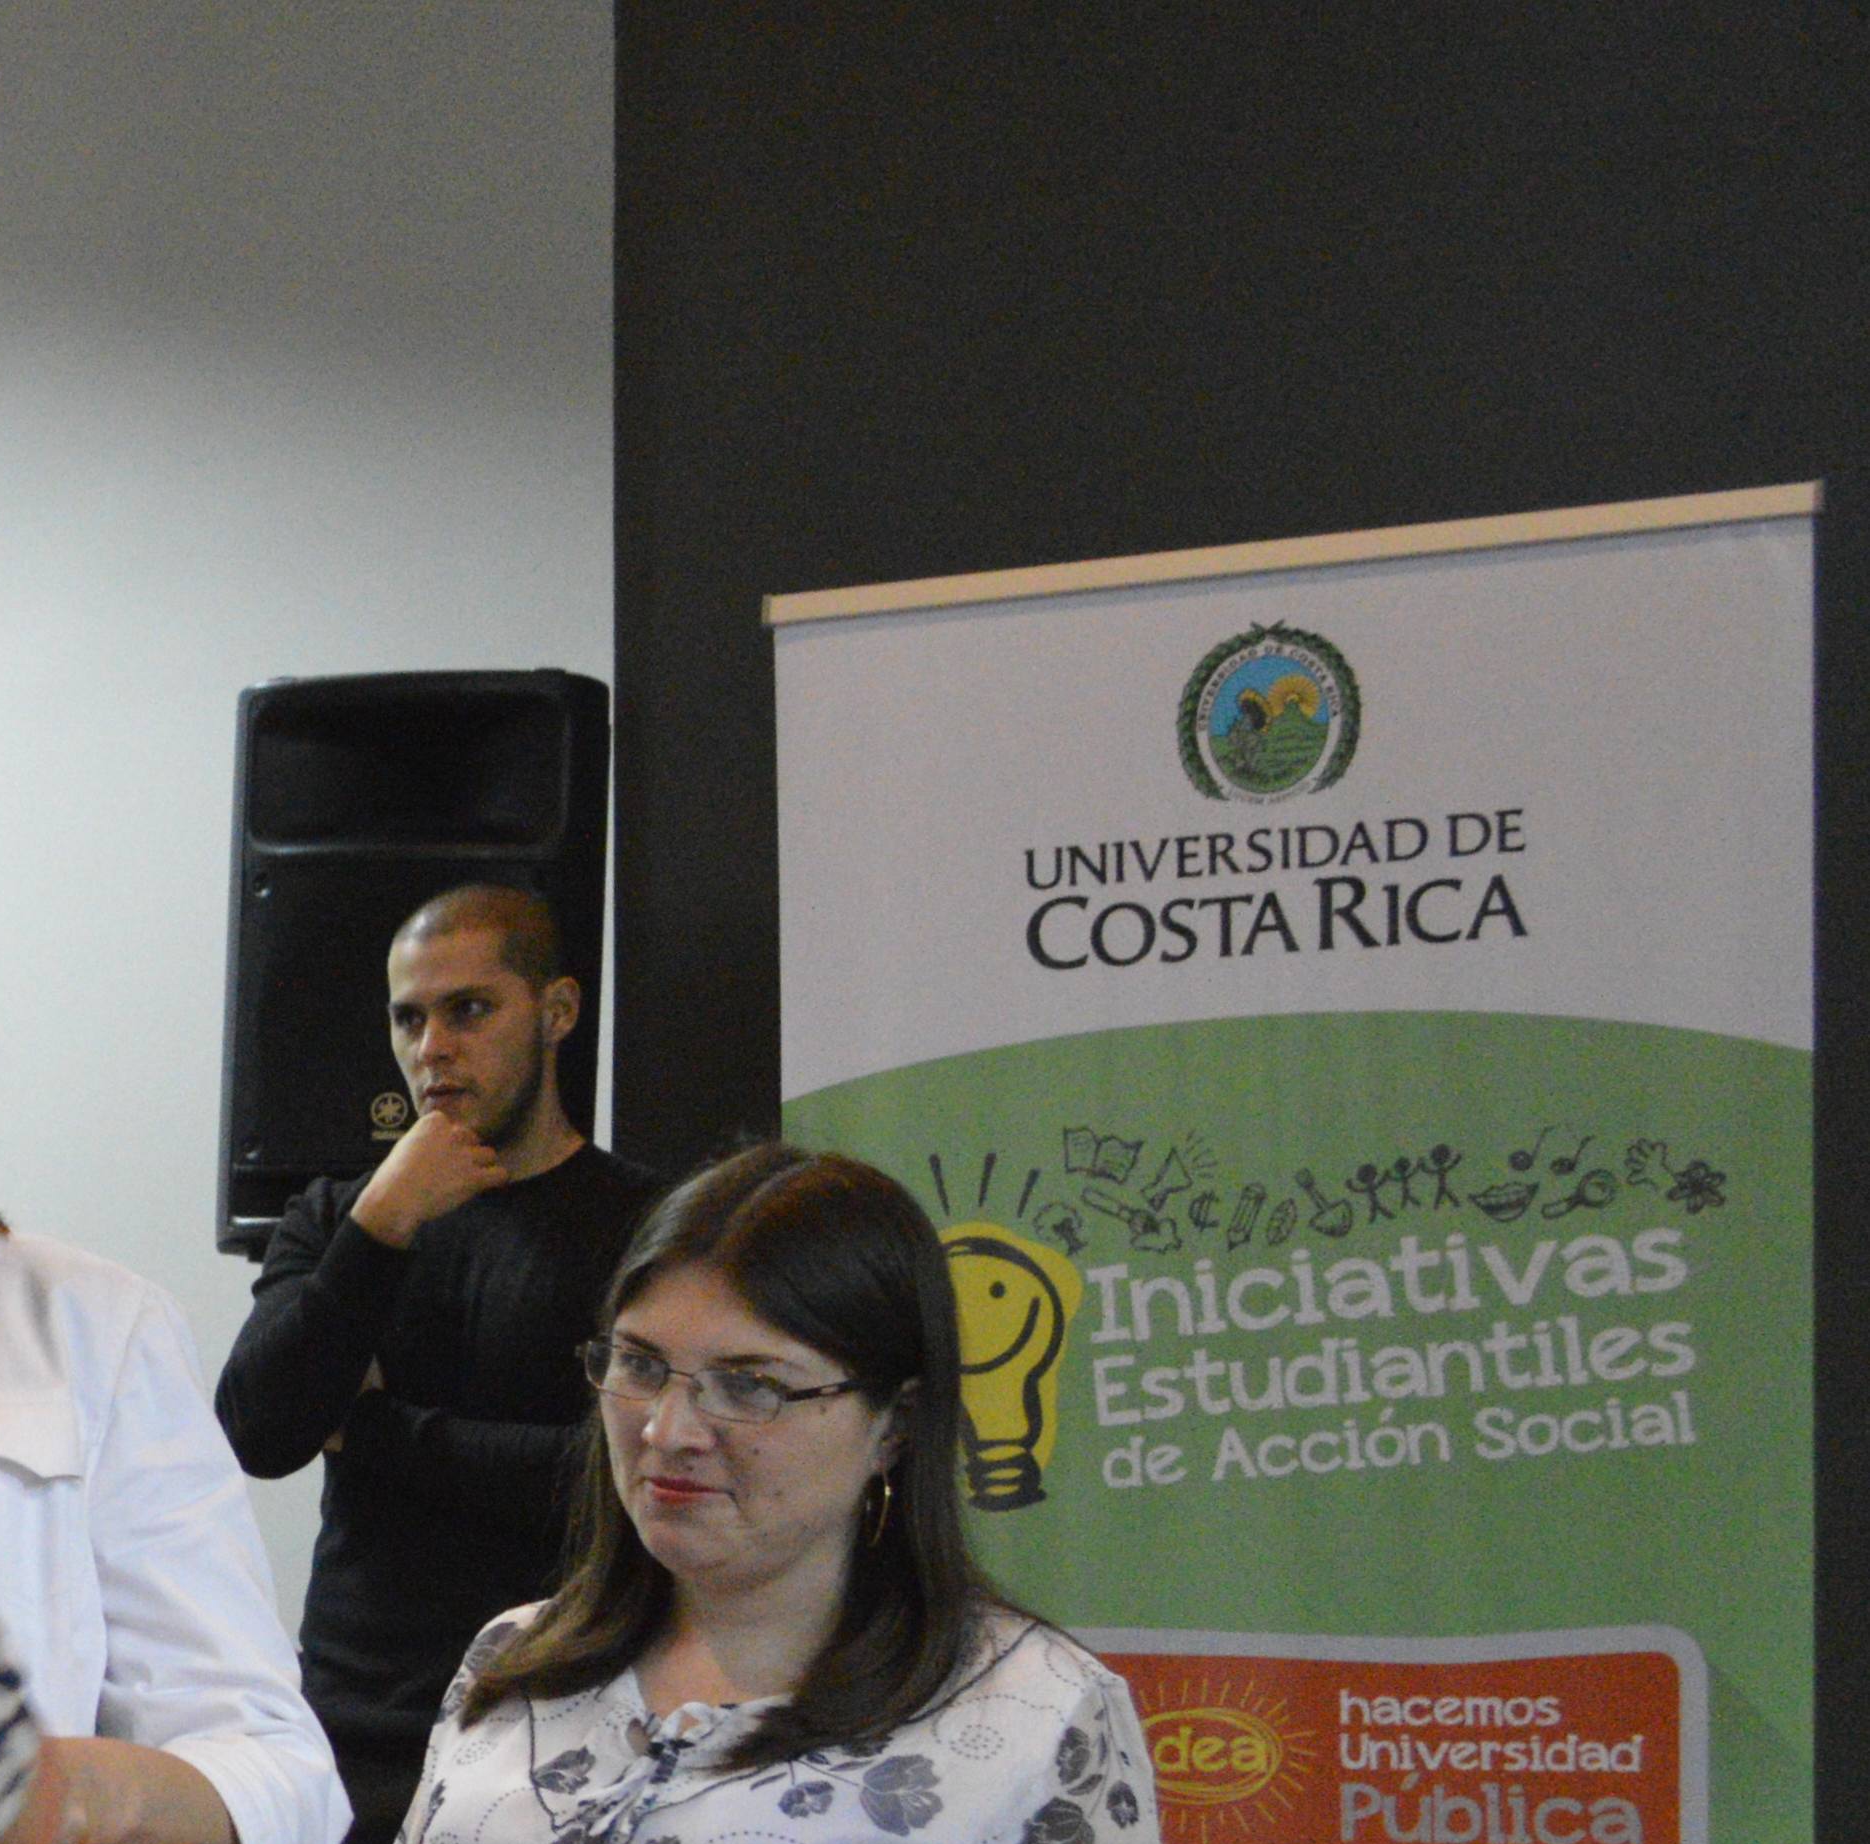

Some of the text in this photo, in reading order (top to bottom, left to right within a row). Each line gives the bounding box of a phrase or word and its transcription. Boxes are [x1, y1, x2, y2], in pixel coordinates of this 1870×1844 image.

[1025, 808, 1527, 891] UNIVERSIDAD DE
[1026, 874, 1529, 971] COSTA RICA
[1087, 1227, 1689, 1344] Iniciativas
[1093, 1316, 1696, 1427] Estudiantiles
[1101, 1391, 1696, 1489] de Acción Social
[1340, 1689, 1563, 1727] hacemos
[1340, 1733, 1645, 1773] Universidad
